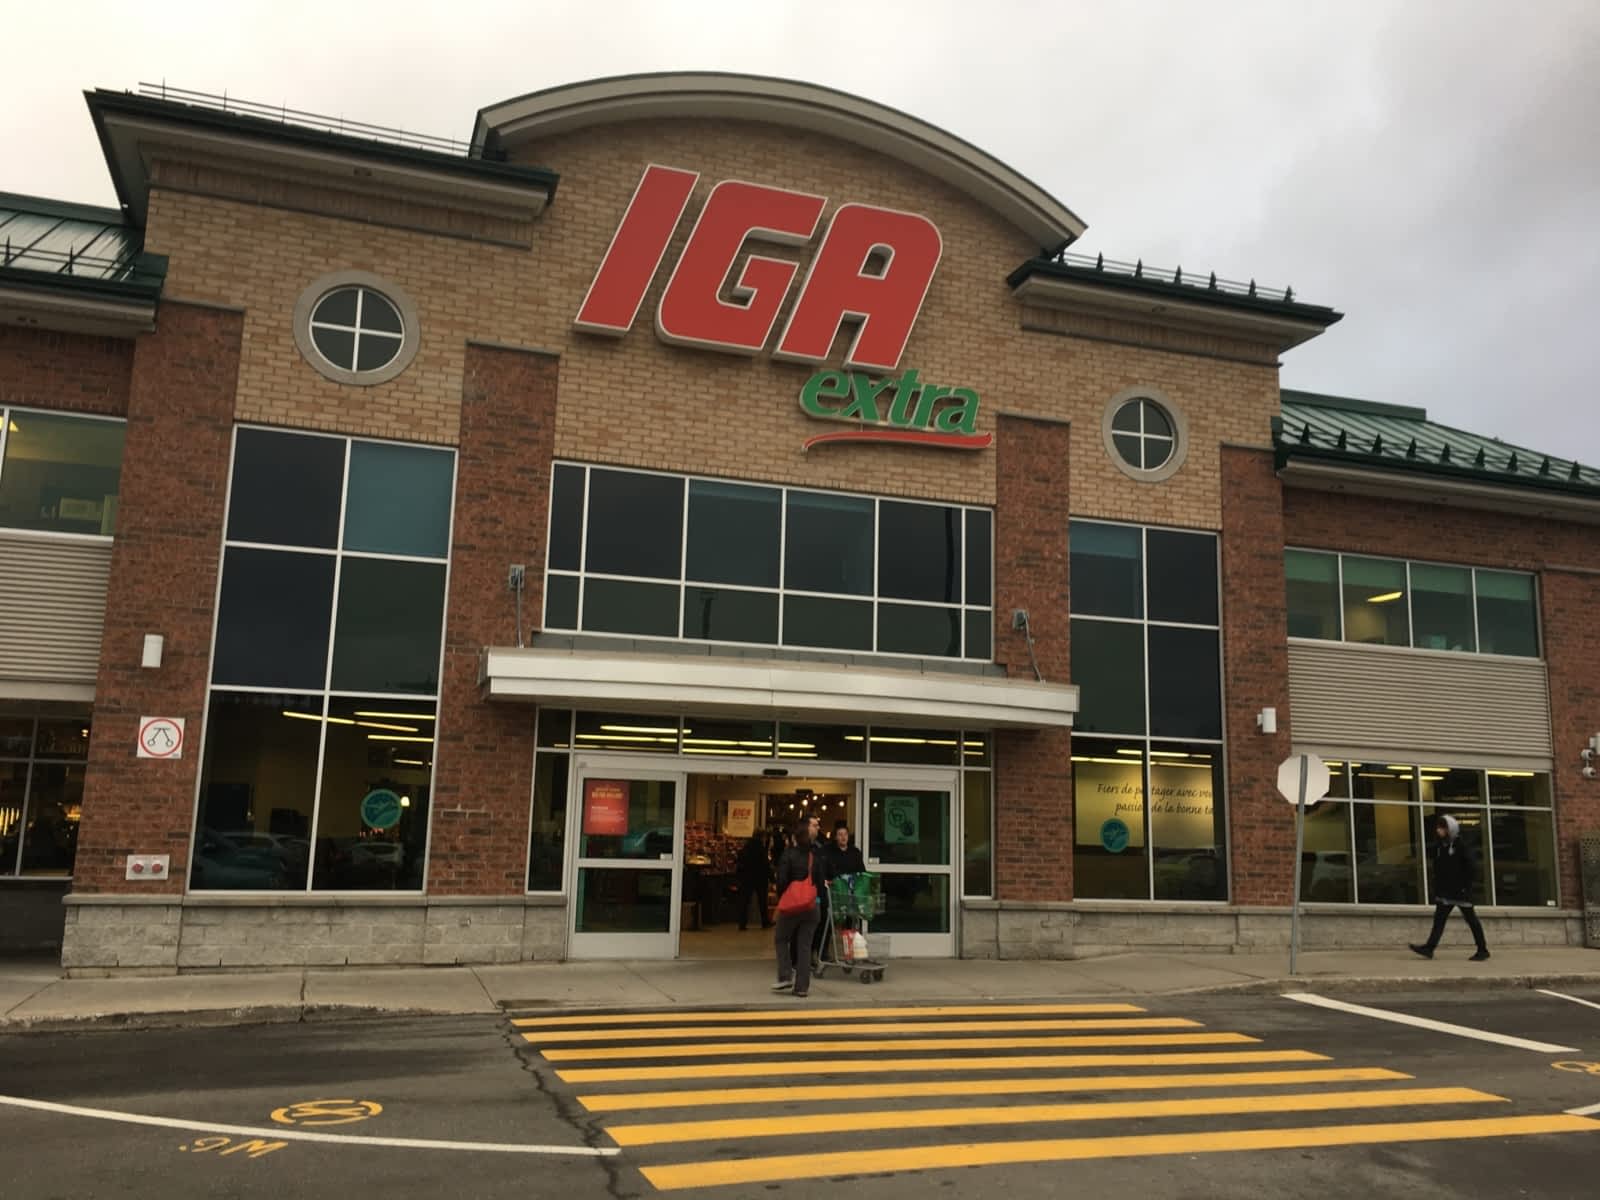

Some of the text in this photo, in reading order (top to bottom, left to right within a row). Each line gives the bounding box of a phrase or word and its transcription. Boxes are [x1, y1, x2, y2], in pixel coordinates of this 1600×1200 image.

[573, 163, 944, 371] IGA
[799, 367, 981, 435] extra
[1121, 782, 1133, 794] de
[1176, 788, 1199, 797] avec
[1151, 801, 1162, 813] de
[1164, 802, 1174, 813] la
[1176, 802, 1201, 815] bonne
